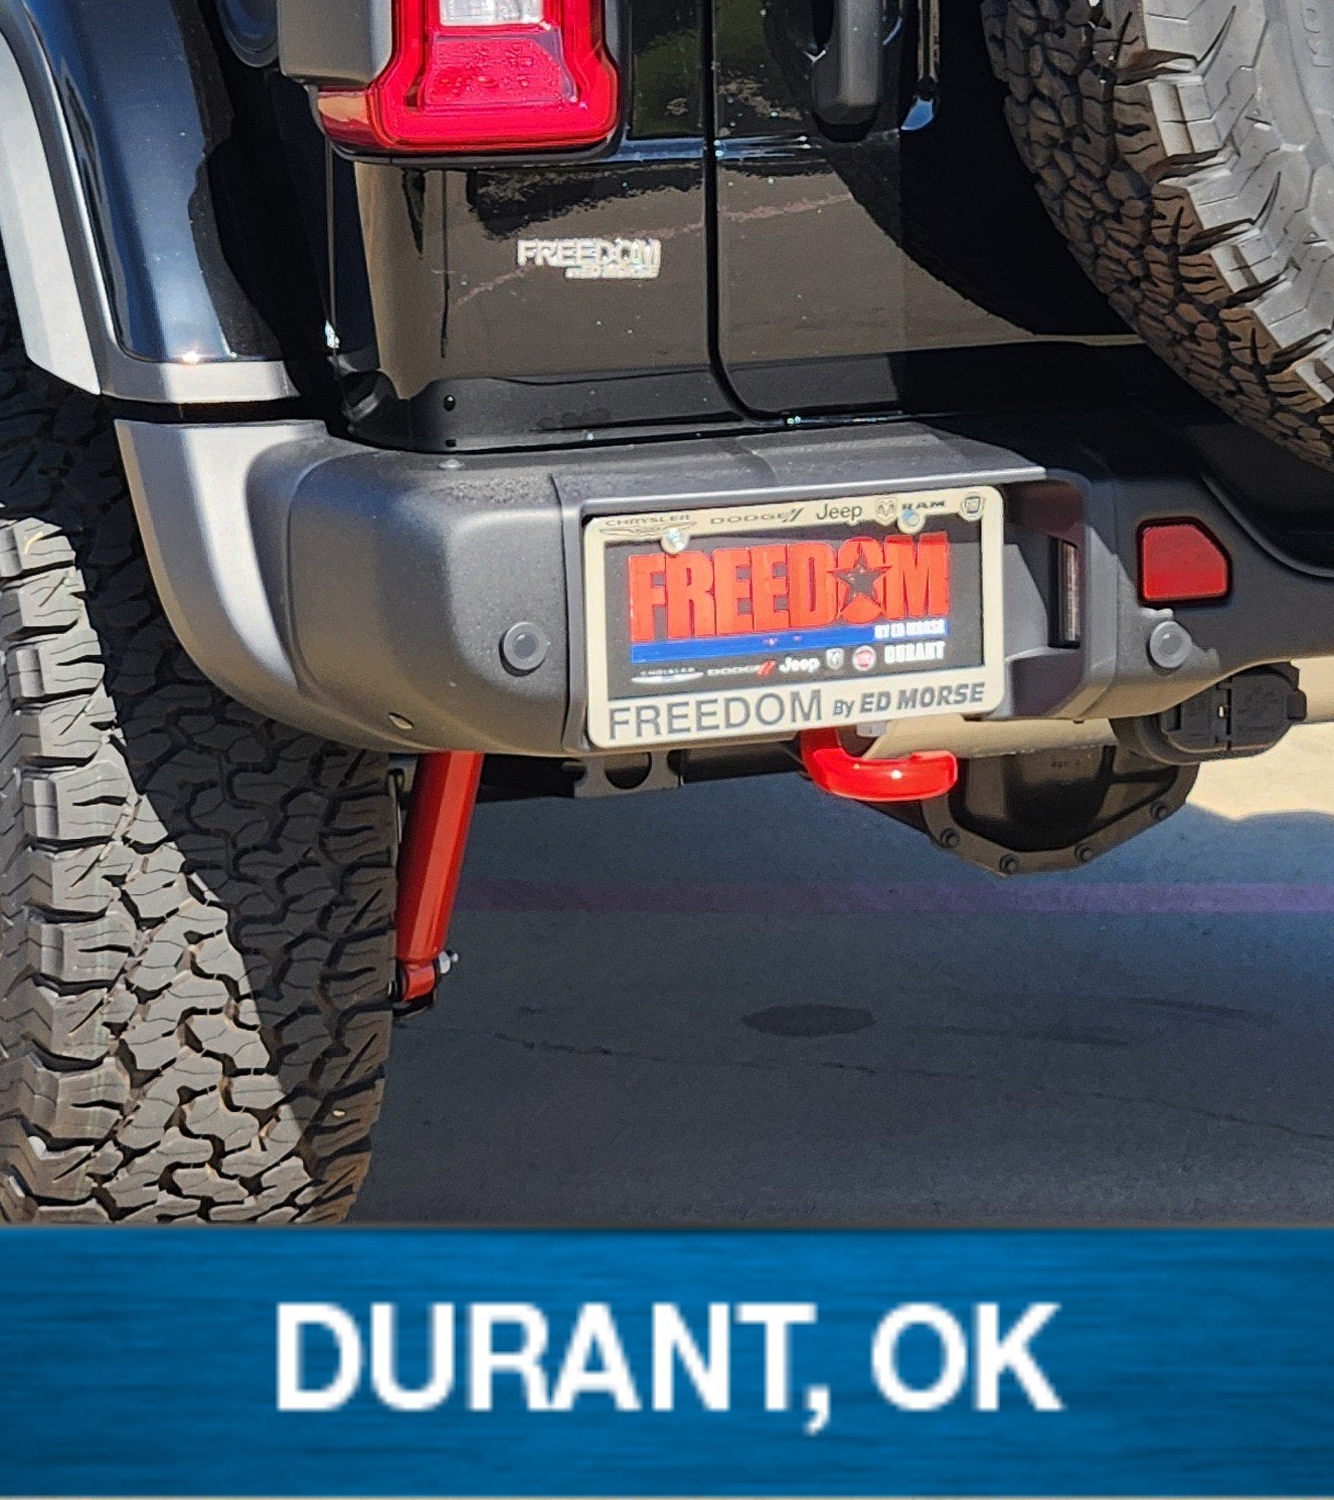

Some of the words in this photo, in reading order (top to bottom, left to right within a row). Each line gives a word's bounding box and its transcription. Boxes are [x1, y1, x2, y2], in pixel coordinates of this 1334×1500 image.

[517, 237, 662, 267] FREEDOM
[605, 513, 691, 527] CHRYSLER
[816, 503, 863, 521] Jeep
[628, 531, 951, 641] FREEDOM
[779, 656, 821, 673] Jeep
[609, 689, 822, 741] FREEDOM
[859, 692, 891, 714] ED
[896, 682, 986, 712] MORSE
